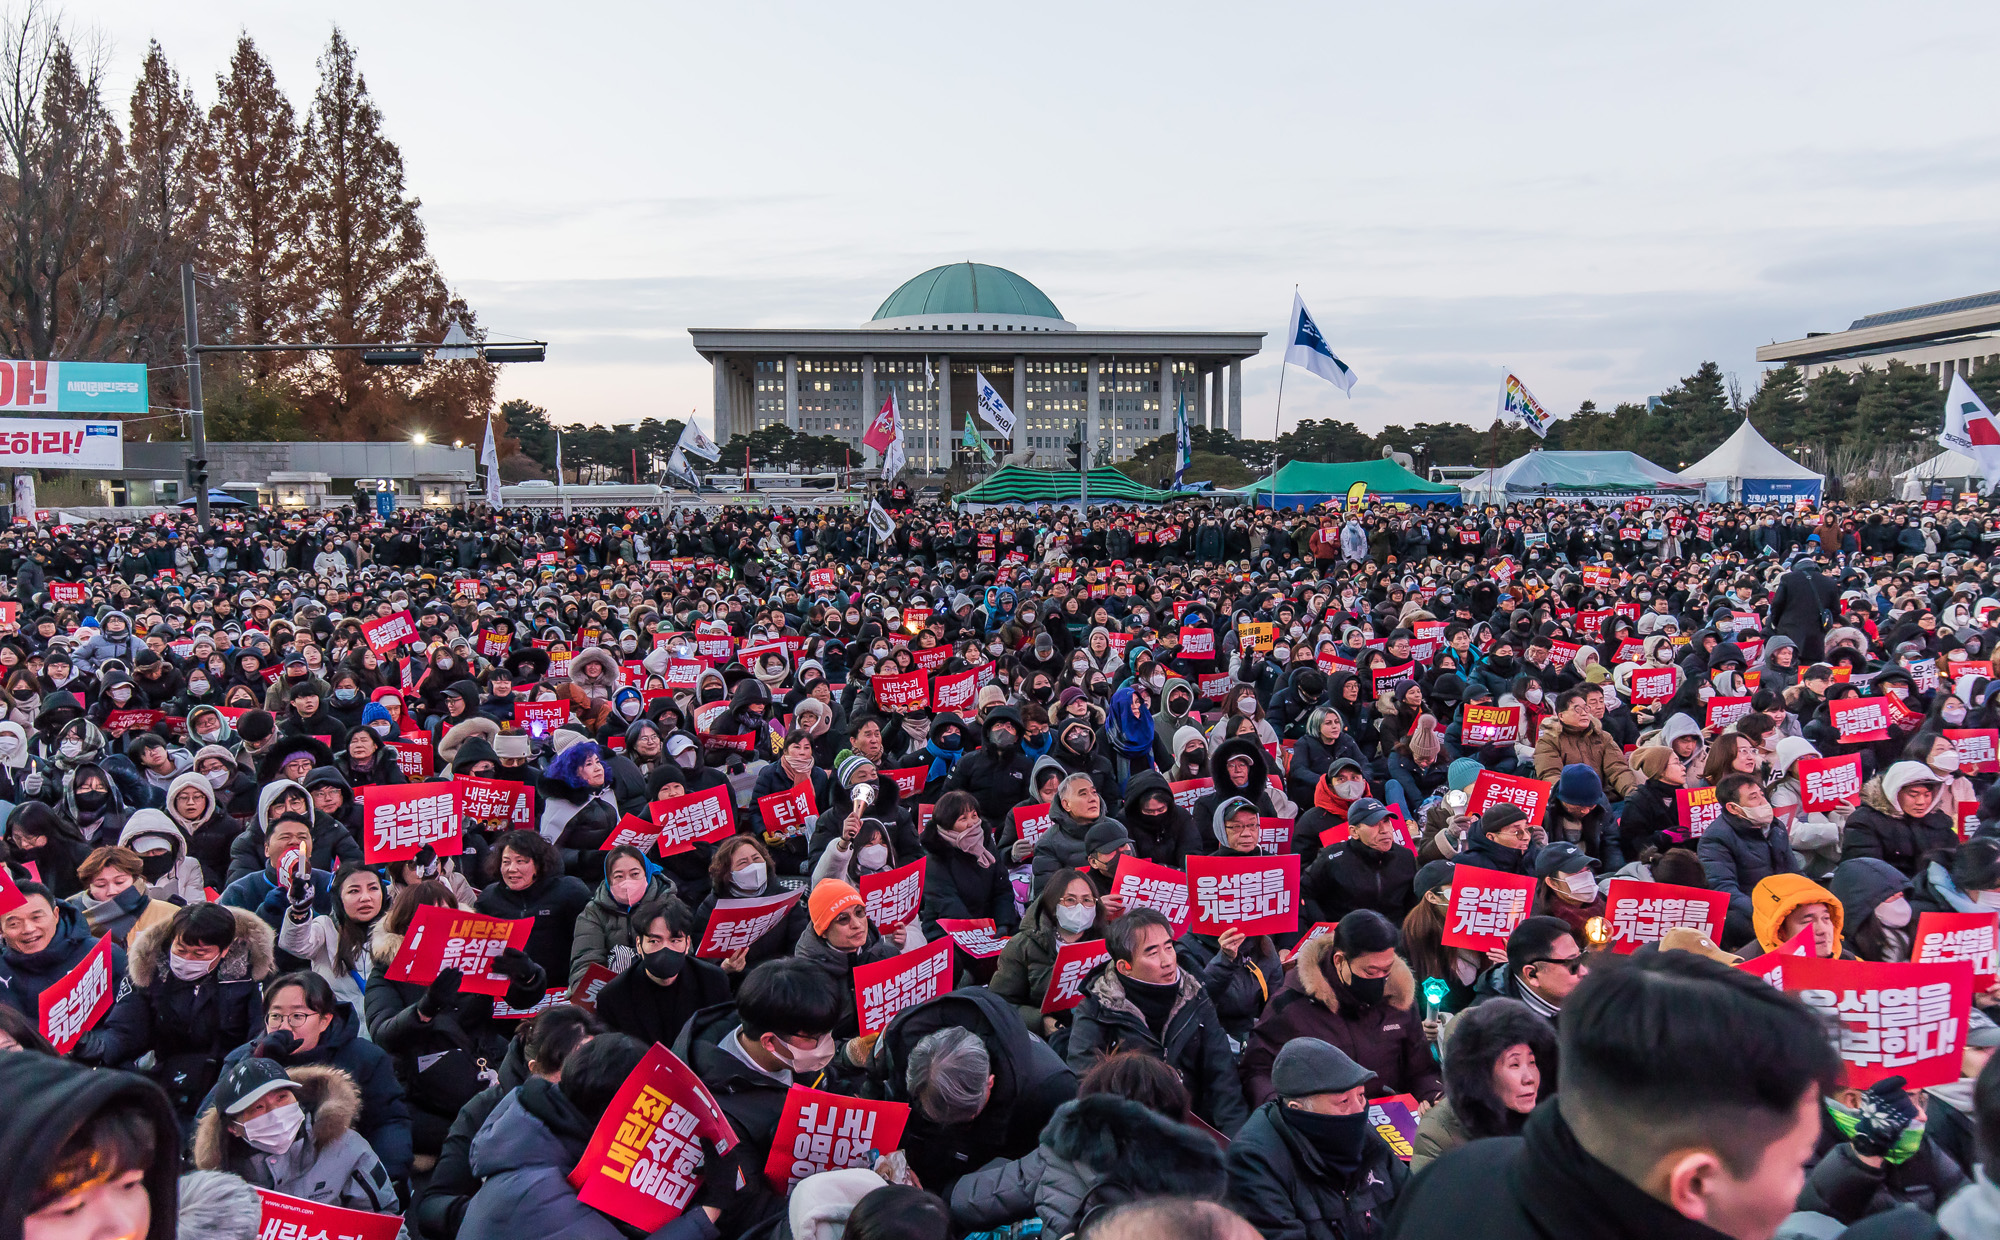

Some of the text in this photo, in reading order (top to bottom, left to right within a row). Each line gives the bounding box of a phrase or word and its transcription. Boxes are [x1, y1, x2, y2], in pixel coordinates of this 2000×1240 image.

[67, 381, 139, 397] 새미래민주당
[377, 479, 388, 492] 2
[810, 573, 831, 586] 탄핵
[368, 616, 407, 640] 윤석열을
[486, 632, 509, 643] 내란죄
[1182, 633, 1213, 646] 윤석열을
[919, 651, 946, 662] 내란수괴
[669, 664, 702, 675] 윤석열을
[882, 678, 919, 691] 내란수괴
[938, 674, 975, 698] 윤석열을
[1202, 676, 1230, 689] 윤석열을
[1635, 684, 1674, 699] 거부한다!
[1637, 674, 1672, 688] 윤석열을
[880, 687, 925, 703] 윤석열 체포
[524, 708, 562, 720] 내란수괴
[1466, 707, 1510, 724] 탄핵이
[1711, 702, 1751, 716] 윤석열을
[1835, 704, 1882, 724] 윤석열을
[549, 717, 565, 729] 체포
[1836, 716, 1888, 736] 거부한다!
[1958, 748, 1996, 764] 부한다!
[896, 774, 916, 792] 핵
[1806, 762, 1857, 788] 윤석열을
[465, 786, 511, 804] 내란수괴
[1486, 783, 1539, 807] 윤석열을
[1807, 777, 1861, 804] 거부한다!
[373, 793, 454, 828] 윤석열을
[492, 803, 510, 817] 체포
[660, 795, 722, 830] 윤석열을
[771, 792, 810, 826] 탄핵
[373, 814, 458, 852] 거부한다!
[662, 808, 728, 849] 거부한다!
[866, 870, 921, 911] 윤석열을
[1119, 874, 1189, 903] 윤석열을
[1197, 868, 1285, 899] 윤석열을
[1199, 889, 1290, 925] 거부한다!
[1458, 886, 1527, 913] 윤석열을
[1614, 898, 1710, 922] 윤석열을
[449, 919, 514, 940] 내란죄
[444, 937, 508, 959] 윤석열
[1922, 925, 1994, 958] 윤석열을
[863, 948, 949, 1010] 채상병특검
[48, 950, 105, 1032] 윤석열을
[48, 967, 108, 1047] 거부한다!
[1840, 1017, 1958, 1068] 부한다!
[600, 1083, 673, 1184] 내란죄
[629, 1105, 700, 1197] 윤석열
[264, 1199, 314, 1216] www.nanum.com
